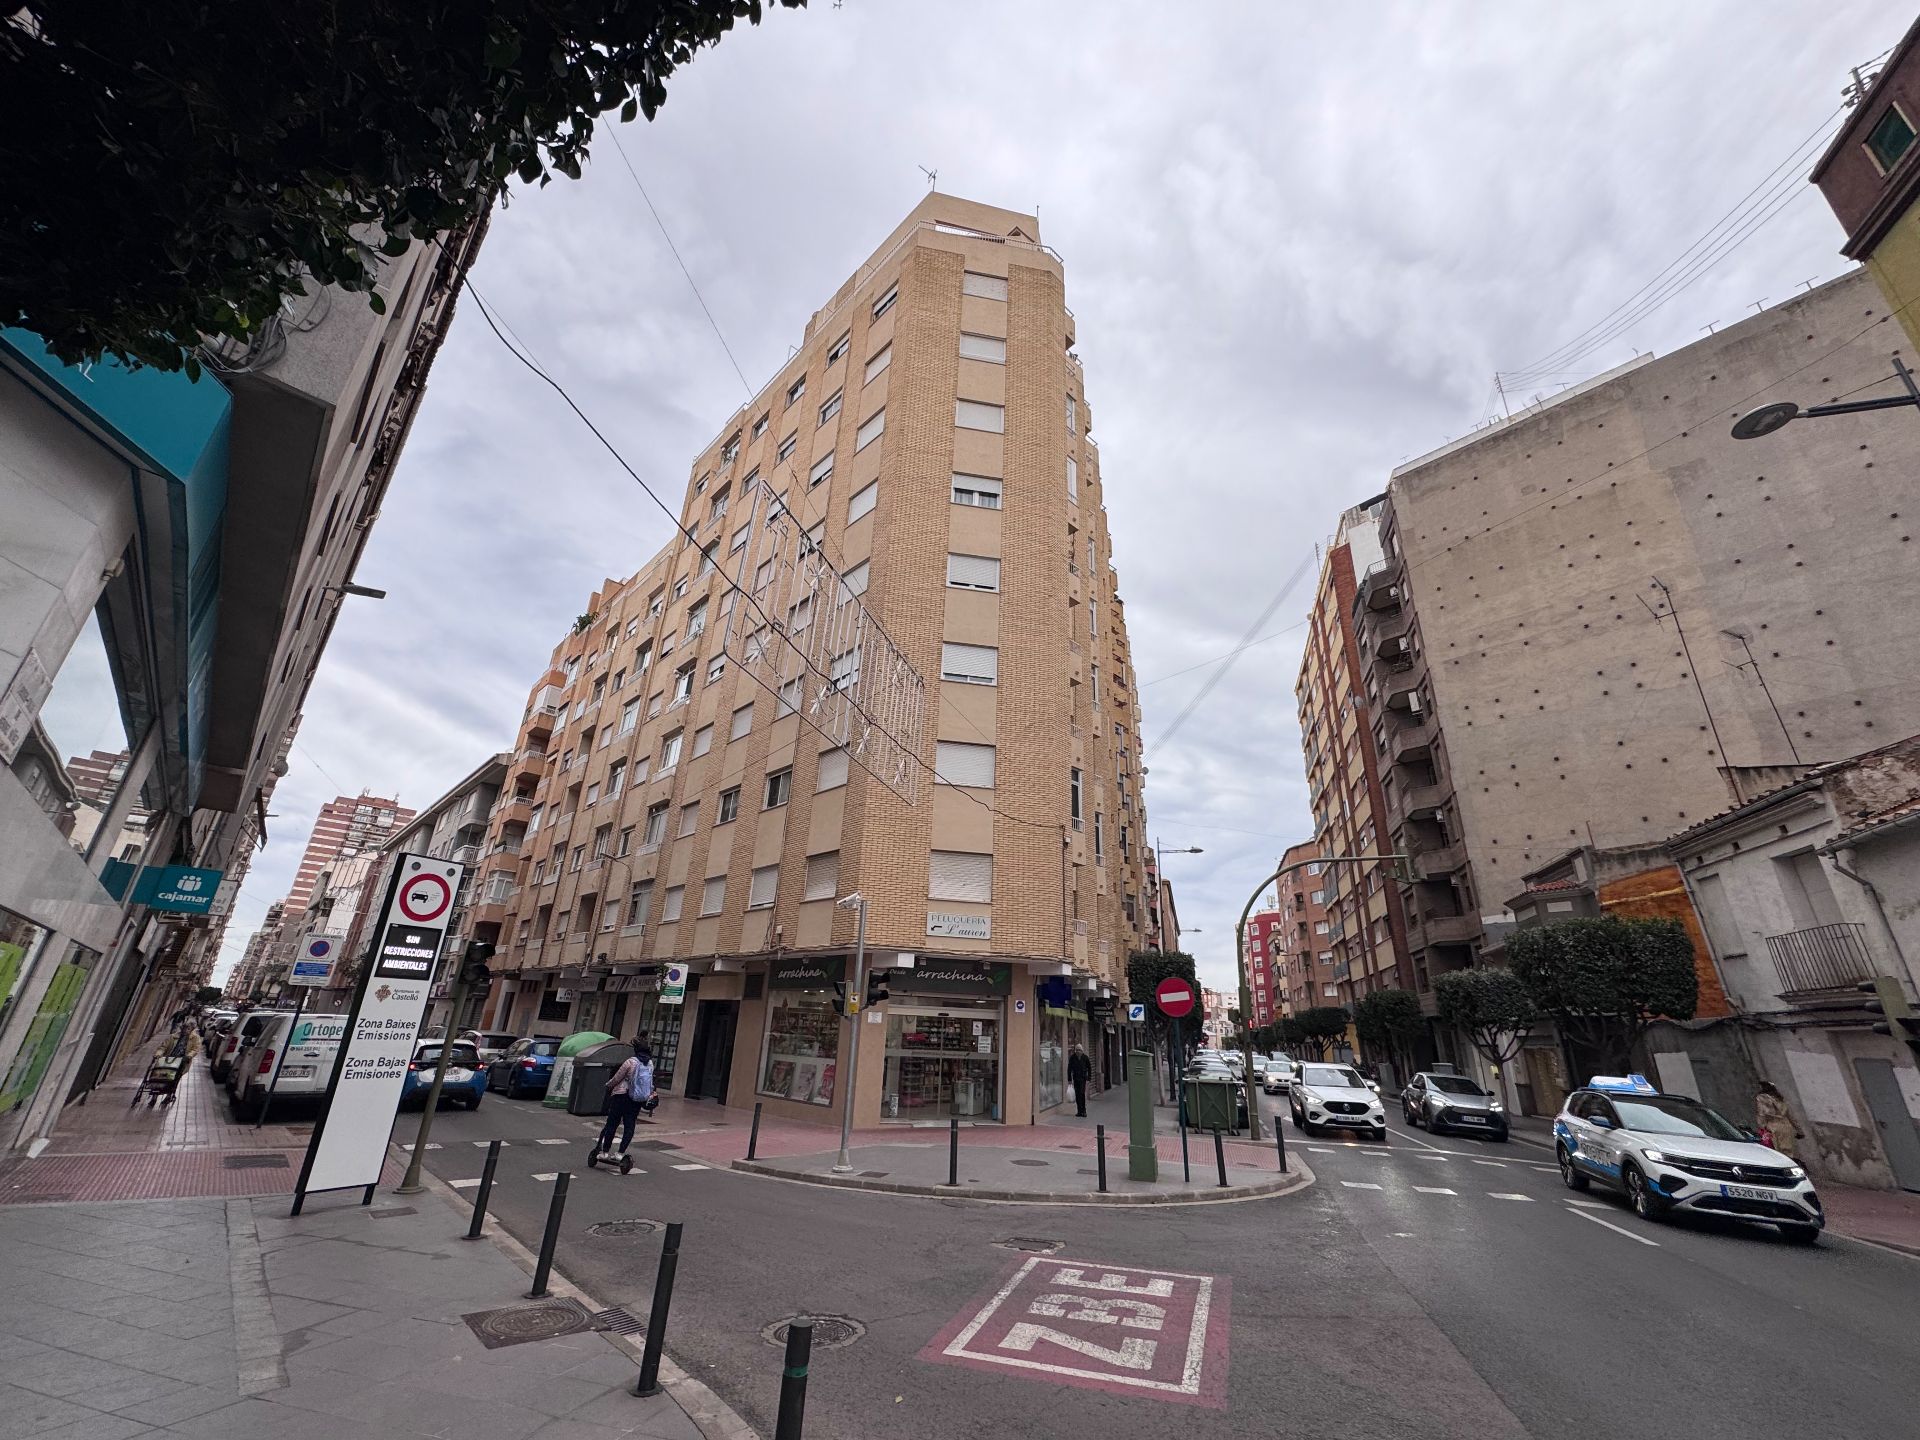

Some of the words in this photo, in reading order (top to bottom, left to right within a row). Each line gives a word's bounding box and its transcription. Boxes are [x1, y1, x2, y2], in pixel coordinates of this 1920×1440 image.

[158, 891, 210, 904] cajamar
[406, 935, 421, 944] SIN
[384, 946, 434, 958] RESTRICCIONES
[382, 959, 428, 971] AMBIENTALES
[778, 966, 822, 979] arrachina
[916, 969, 986, 981] arrachina
[357, 1018, 383, 1029] Zona
[385, 1019, 417, 1029] Baixes
[303, 1022, 343, 1038] Ortope
[356, 1029, 412, 1041] Emissions
[345, 1057, 374, 1068] Zona
[377, 1057, 407, 1069] Bajas
[344, 1069, 402, 1080] Emisiones
[1729, 1187, 1754, 1198] 5520
[997, 1267, 1175, 1372] ZBE
